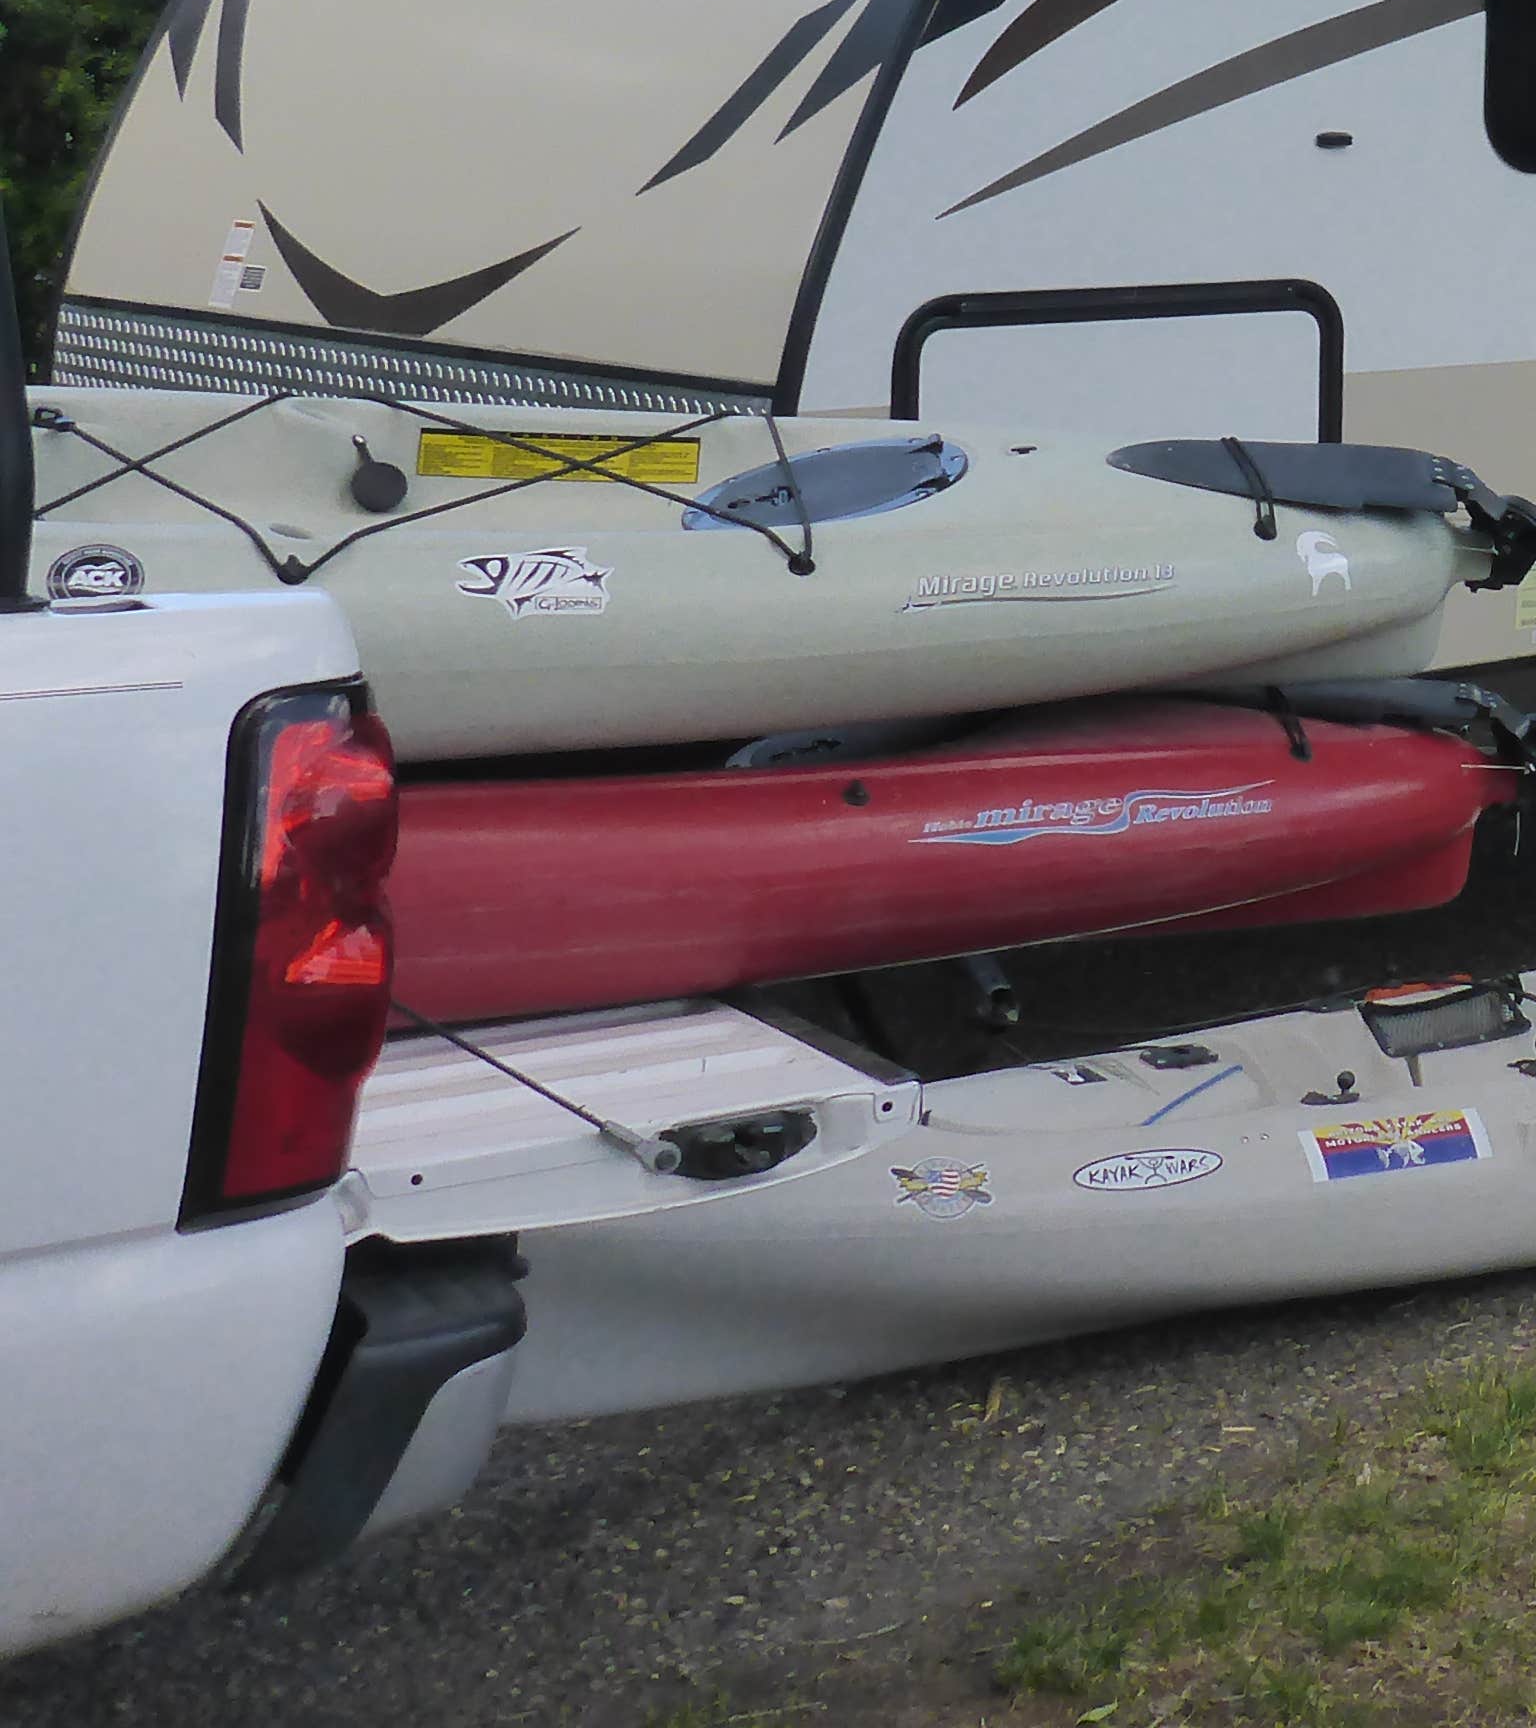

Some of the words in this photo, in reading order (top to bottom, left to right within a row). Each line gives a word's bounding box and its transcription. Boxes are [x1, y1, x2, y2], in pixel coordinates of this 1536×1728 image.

[67, 570, 126, 587] ACK
[917, 573, 1015, 598] Mirage
[1023, 565, 1148, 589] Revolution
[974, 797, 1126, 826] mirage
[1133, 794, 1273, 824] Revolution
[1089, 1164, 1143, 1185] KAYAK
[1165, 1155, 1208, 1175] WARS
